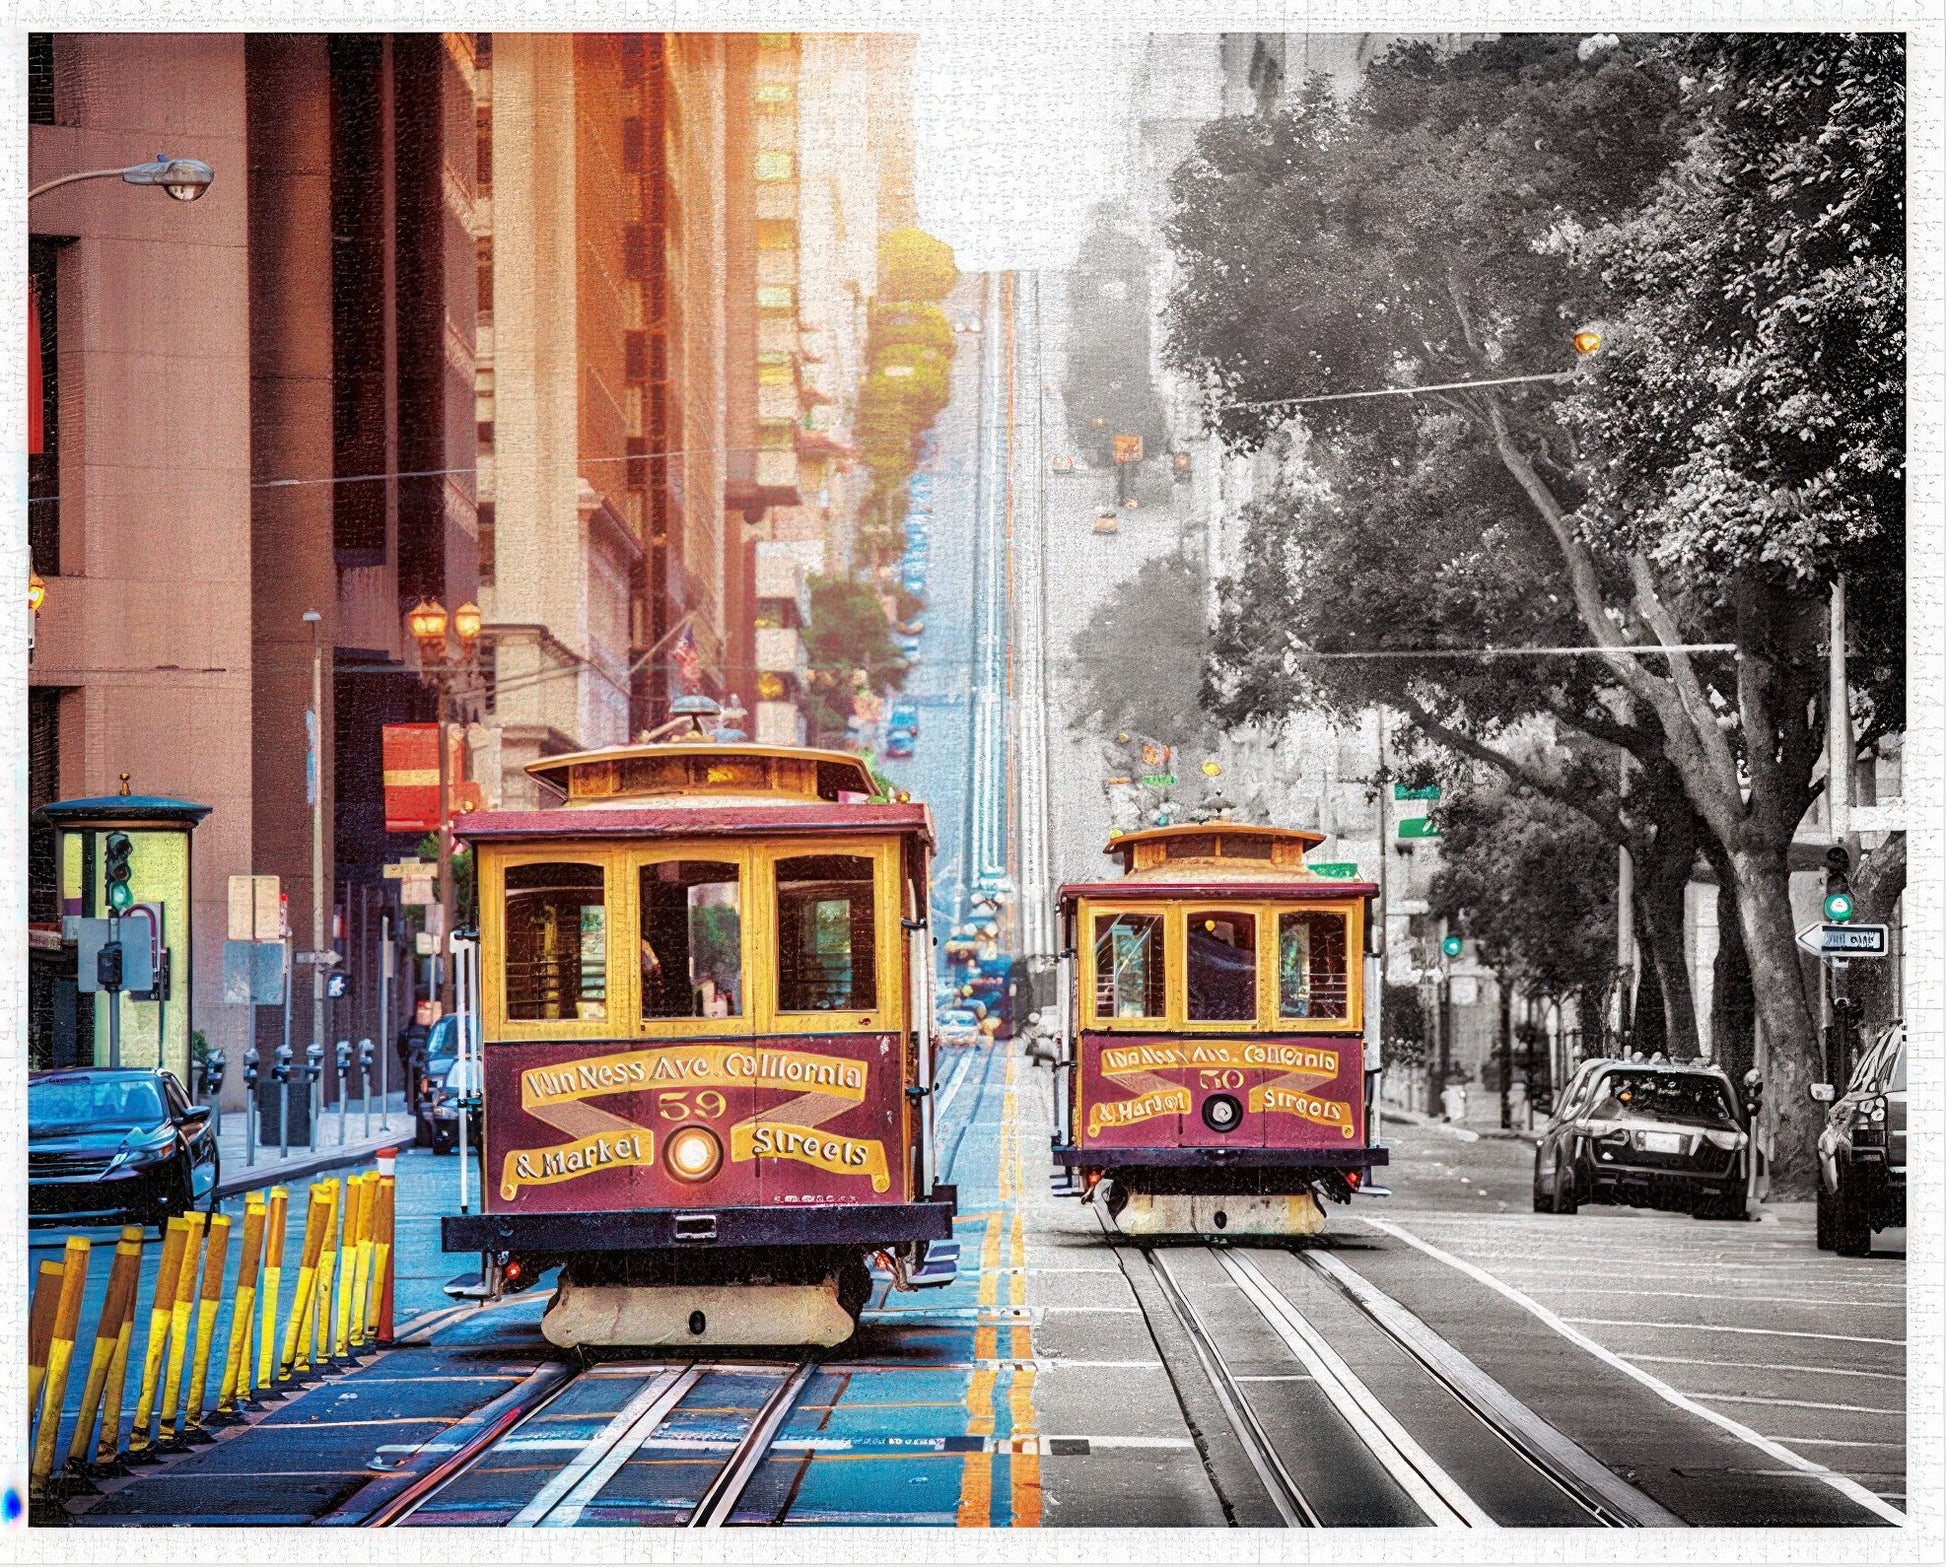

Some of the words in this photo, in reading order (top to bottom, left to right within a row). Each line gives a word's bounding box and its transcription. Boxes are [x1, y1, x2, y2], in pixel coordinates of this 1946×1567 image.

[576, 1060, 646, 1090] Ness
[658, 1090, 727, 1121] 59
[517, 1153, 541, 1179] &
[541, 1135, 642, 1178] Market
[752, 1127, 869, 1166] Streets
